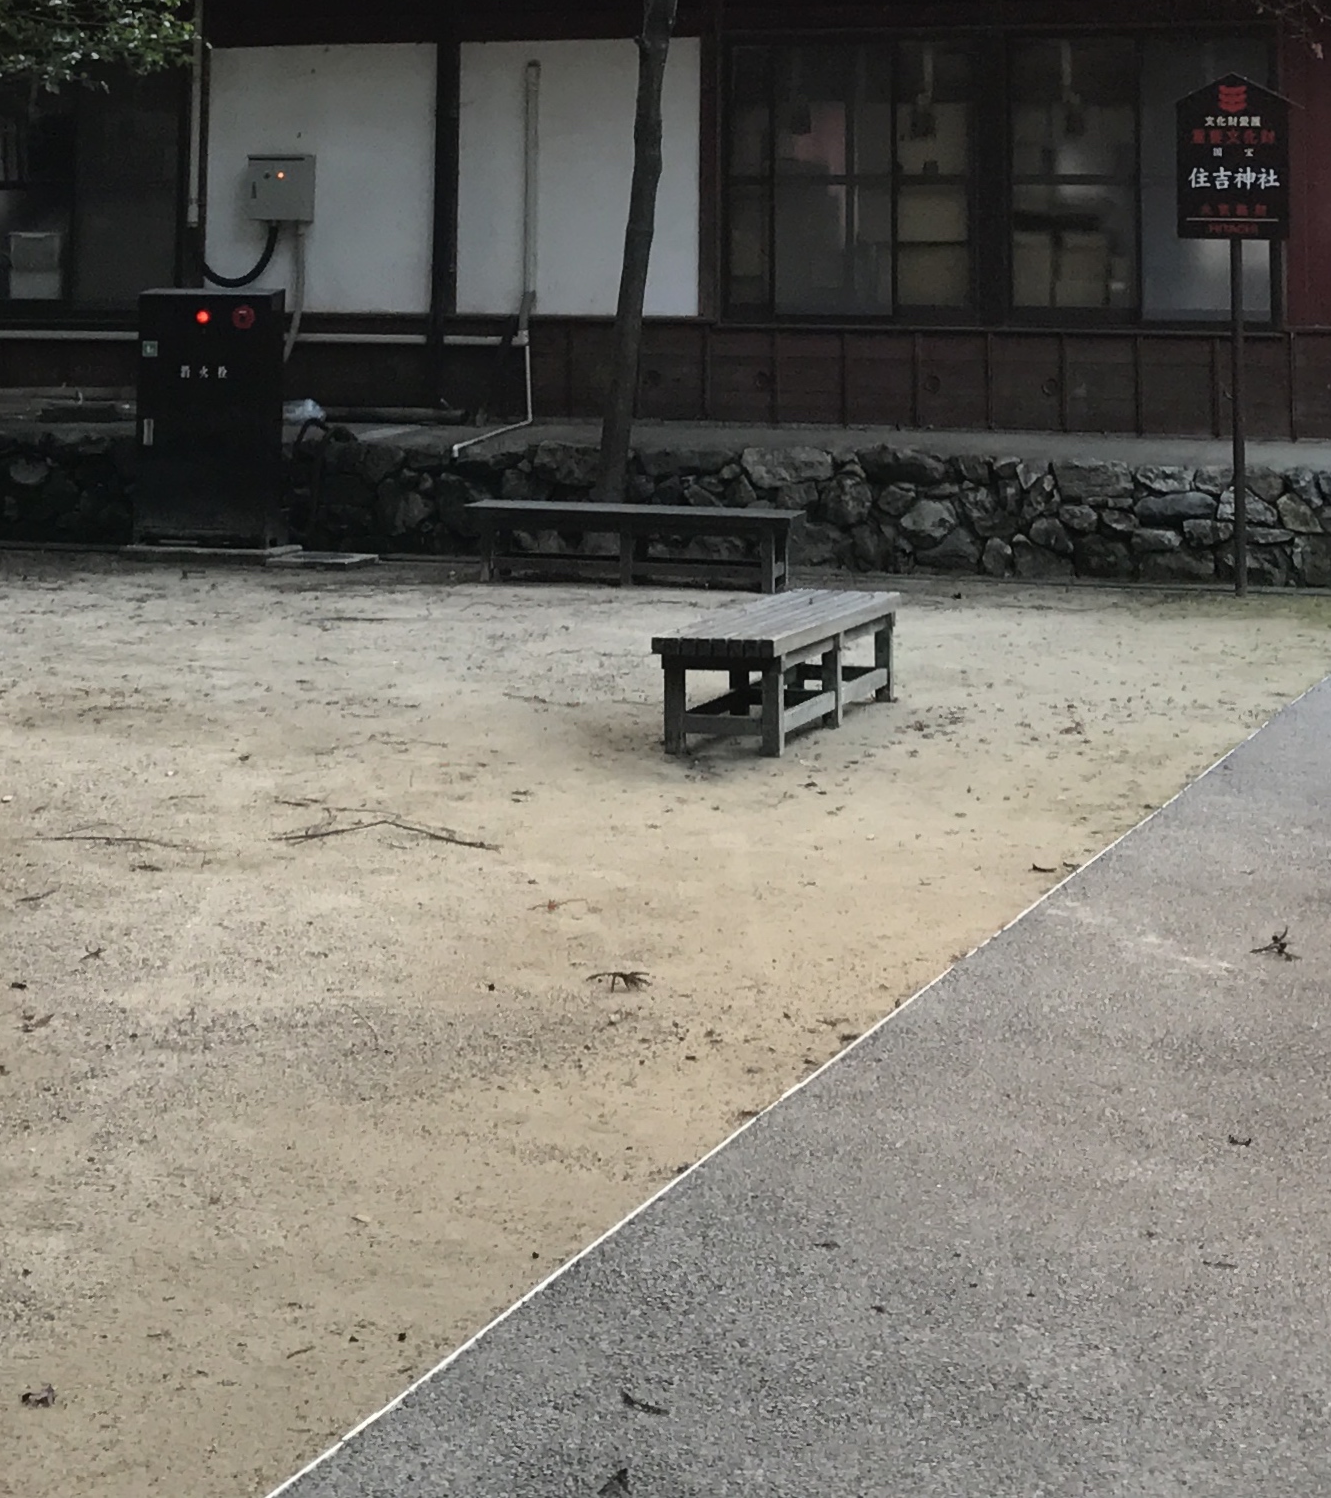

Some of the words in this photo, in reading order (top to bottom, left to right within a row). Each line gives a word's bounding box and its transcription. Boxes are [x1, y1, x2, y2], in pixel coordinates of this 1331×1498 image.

[1188, 166, 1280, 190] 住吉神社
[180, 365, 228, 379] 消火栓
